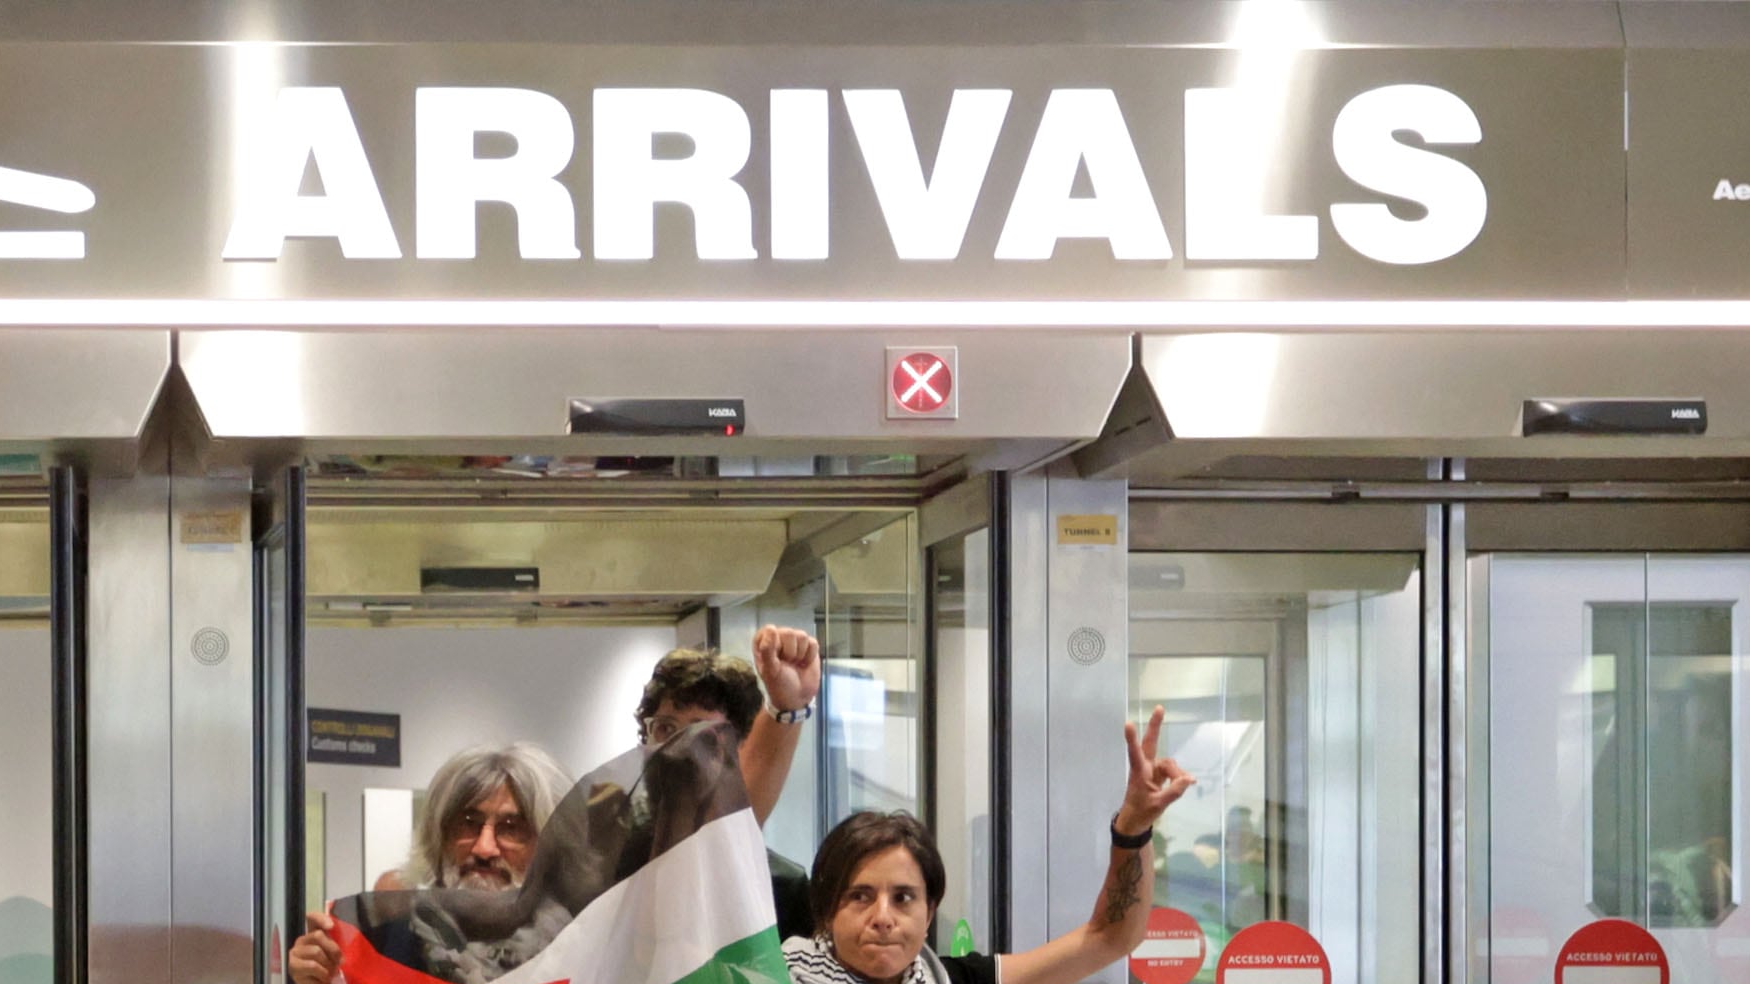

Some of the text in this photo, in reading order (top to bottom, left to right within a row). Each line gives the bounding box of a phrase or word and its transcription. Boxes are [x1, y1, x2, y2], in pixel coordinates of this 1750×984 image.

[222, 85, 1487, 264] ARRIVALS
[1228, 955, 1320, 965] ACCESSO VIETATO
[1566, 953, 1658, 962] ACCESSO VIETATO
